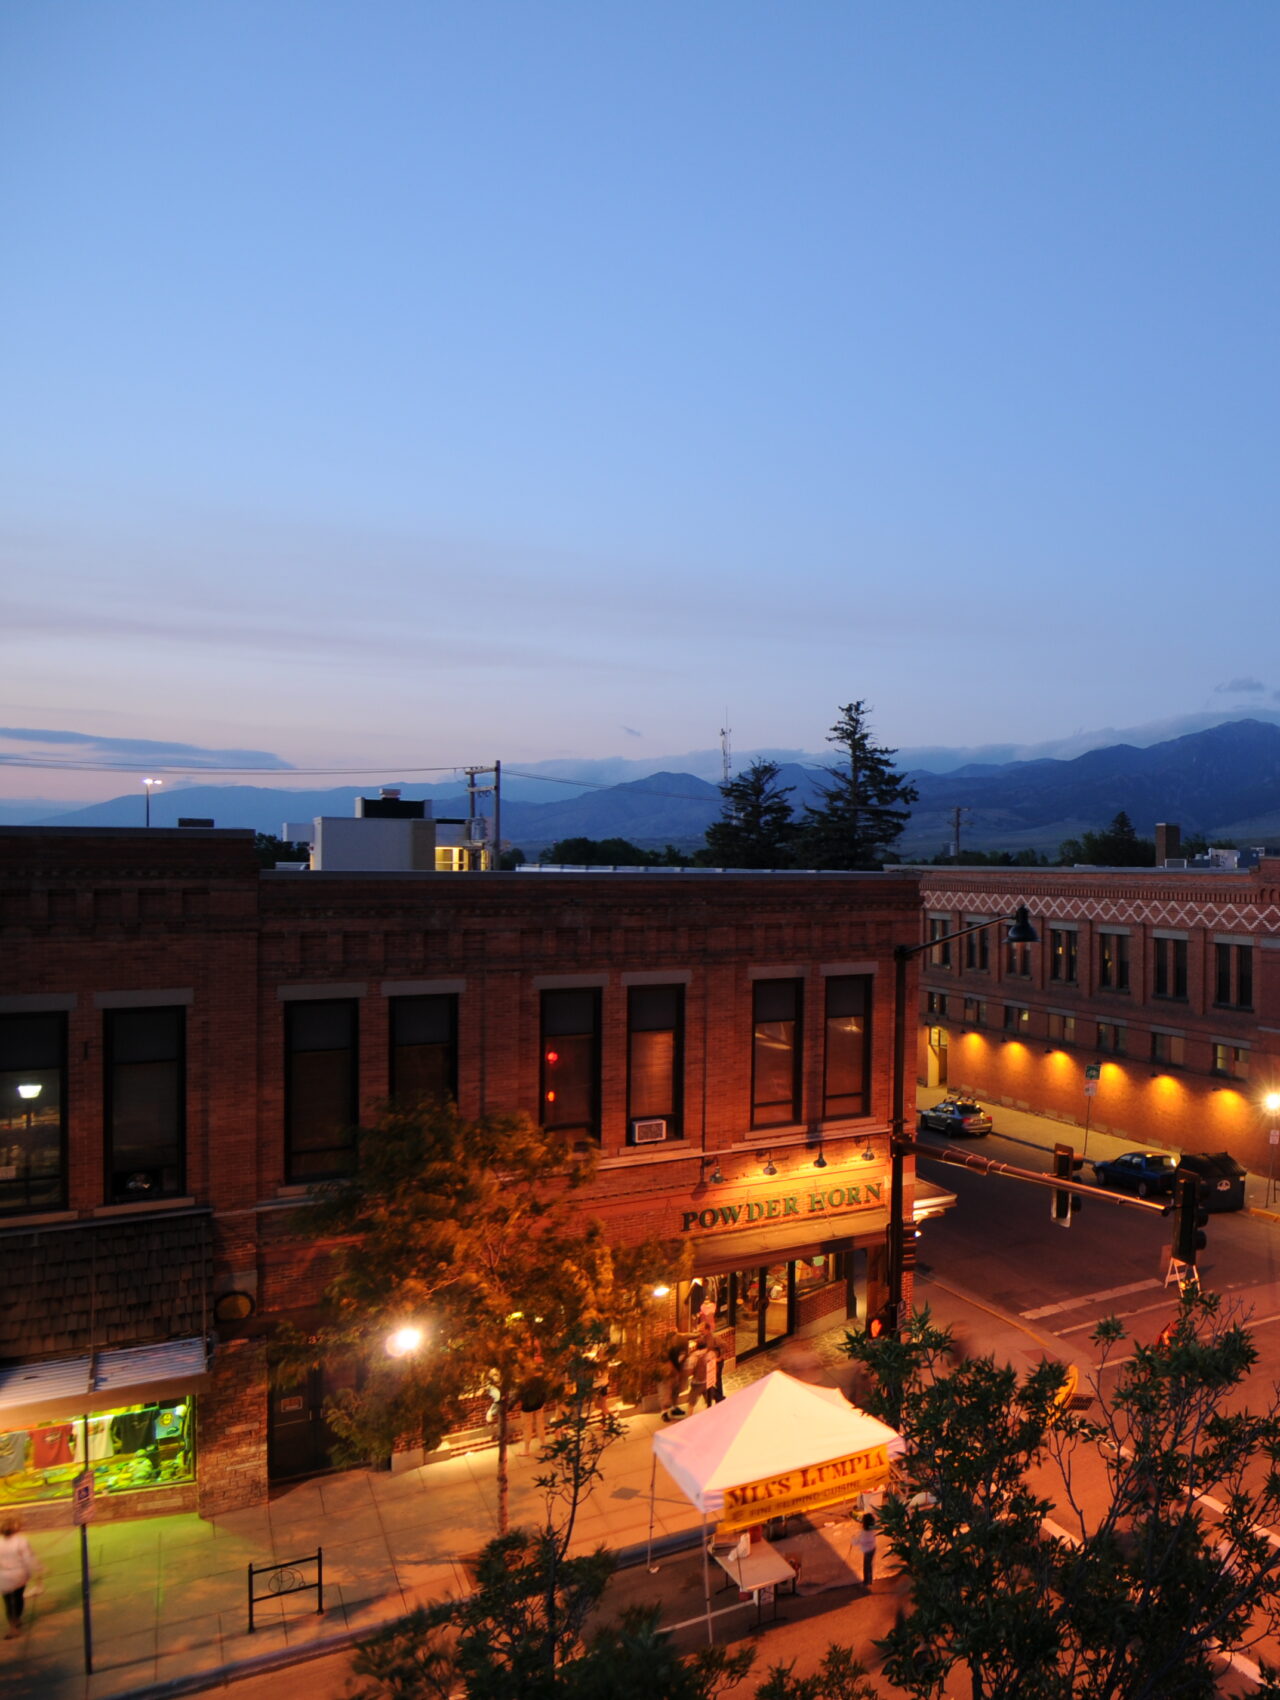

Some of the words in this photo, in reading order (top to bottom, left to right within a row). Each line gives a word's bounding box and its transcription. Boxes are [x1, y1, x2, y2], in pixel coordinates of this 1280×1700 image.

[681, 1196, 800, 1232] POWDER
[808, 1182, 882, 1213] HORN
[800, 1450, 885, 1488] LUMPIA
